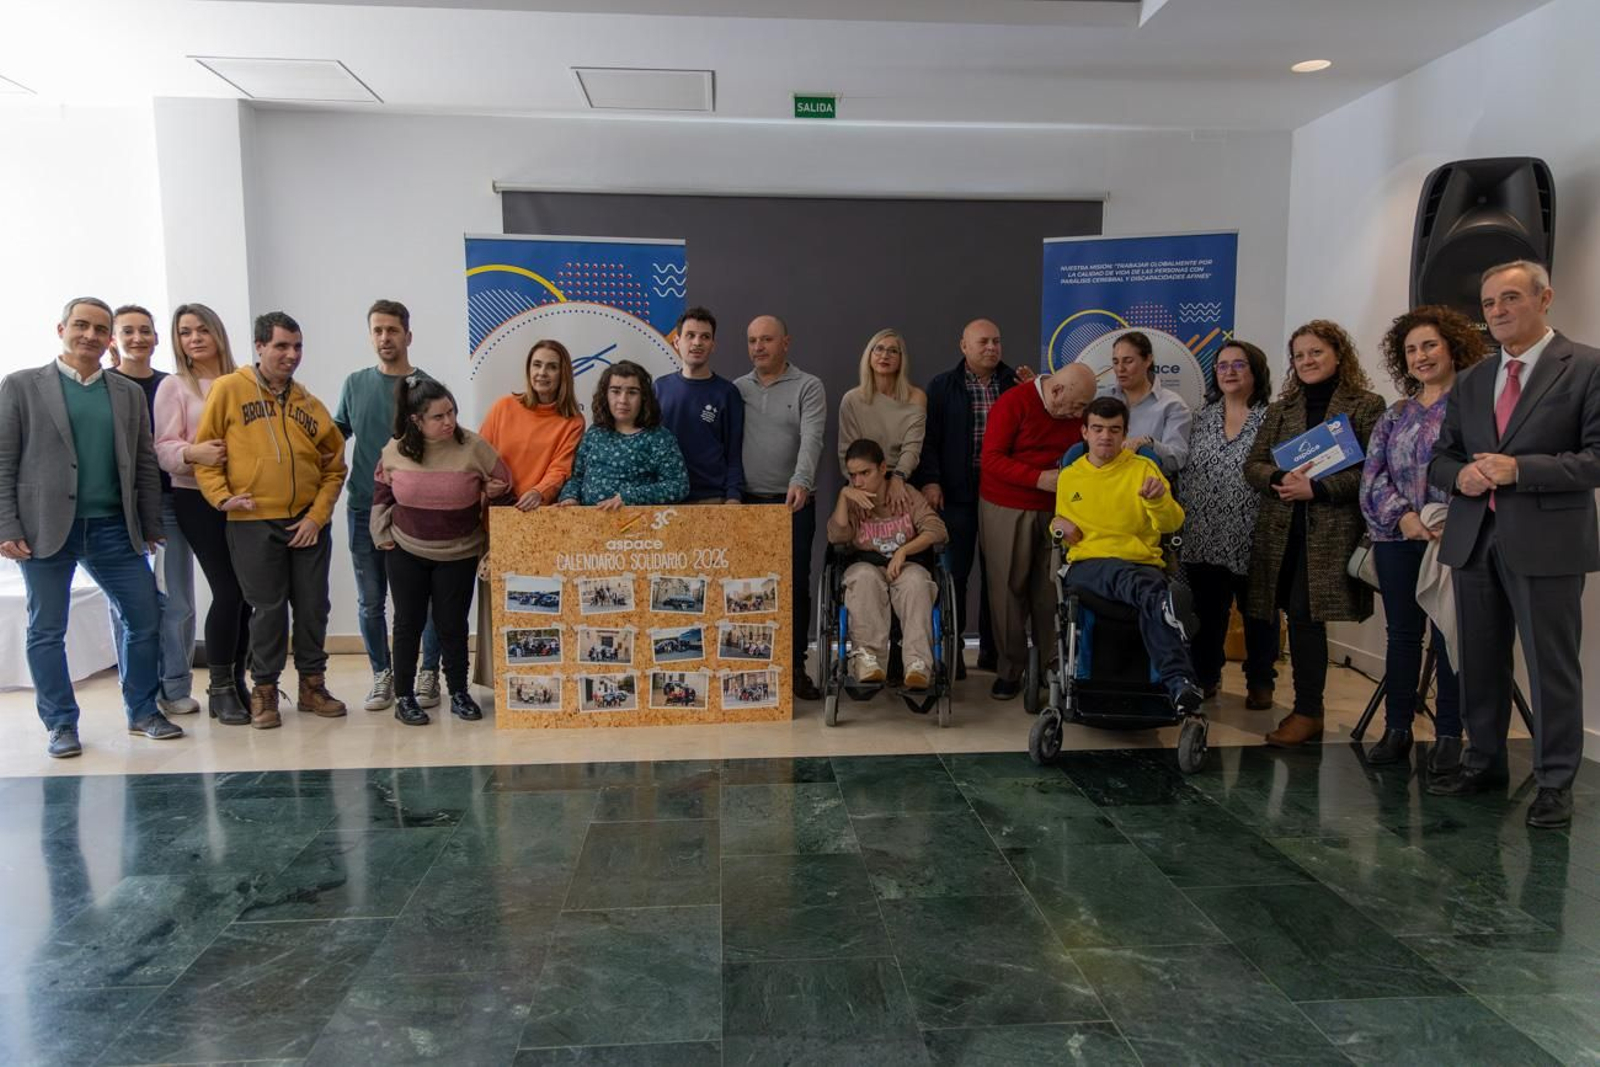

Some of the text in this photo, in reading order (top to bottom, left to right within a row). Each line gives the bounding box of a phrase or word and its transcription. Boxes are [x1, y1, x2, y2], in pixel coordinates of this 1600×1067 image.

[797, 102, 833, 112] SALIDA
[242, 400, 319, 438] BRONX LIONS
[1294, 444, 1320, 462] aspace
[606, 539, 663, 551] aspace
[556, 549, 729, 571] CALENDARIO SOLIDARIO 2026
